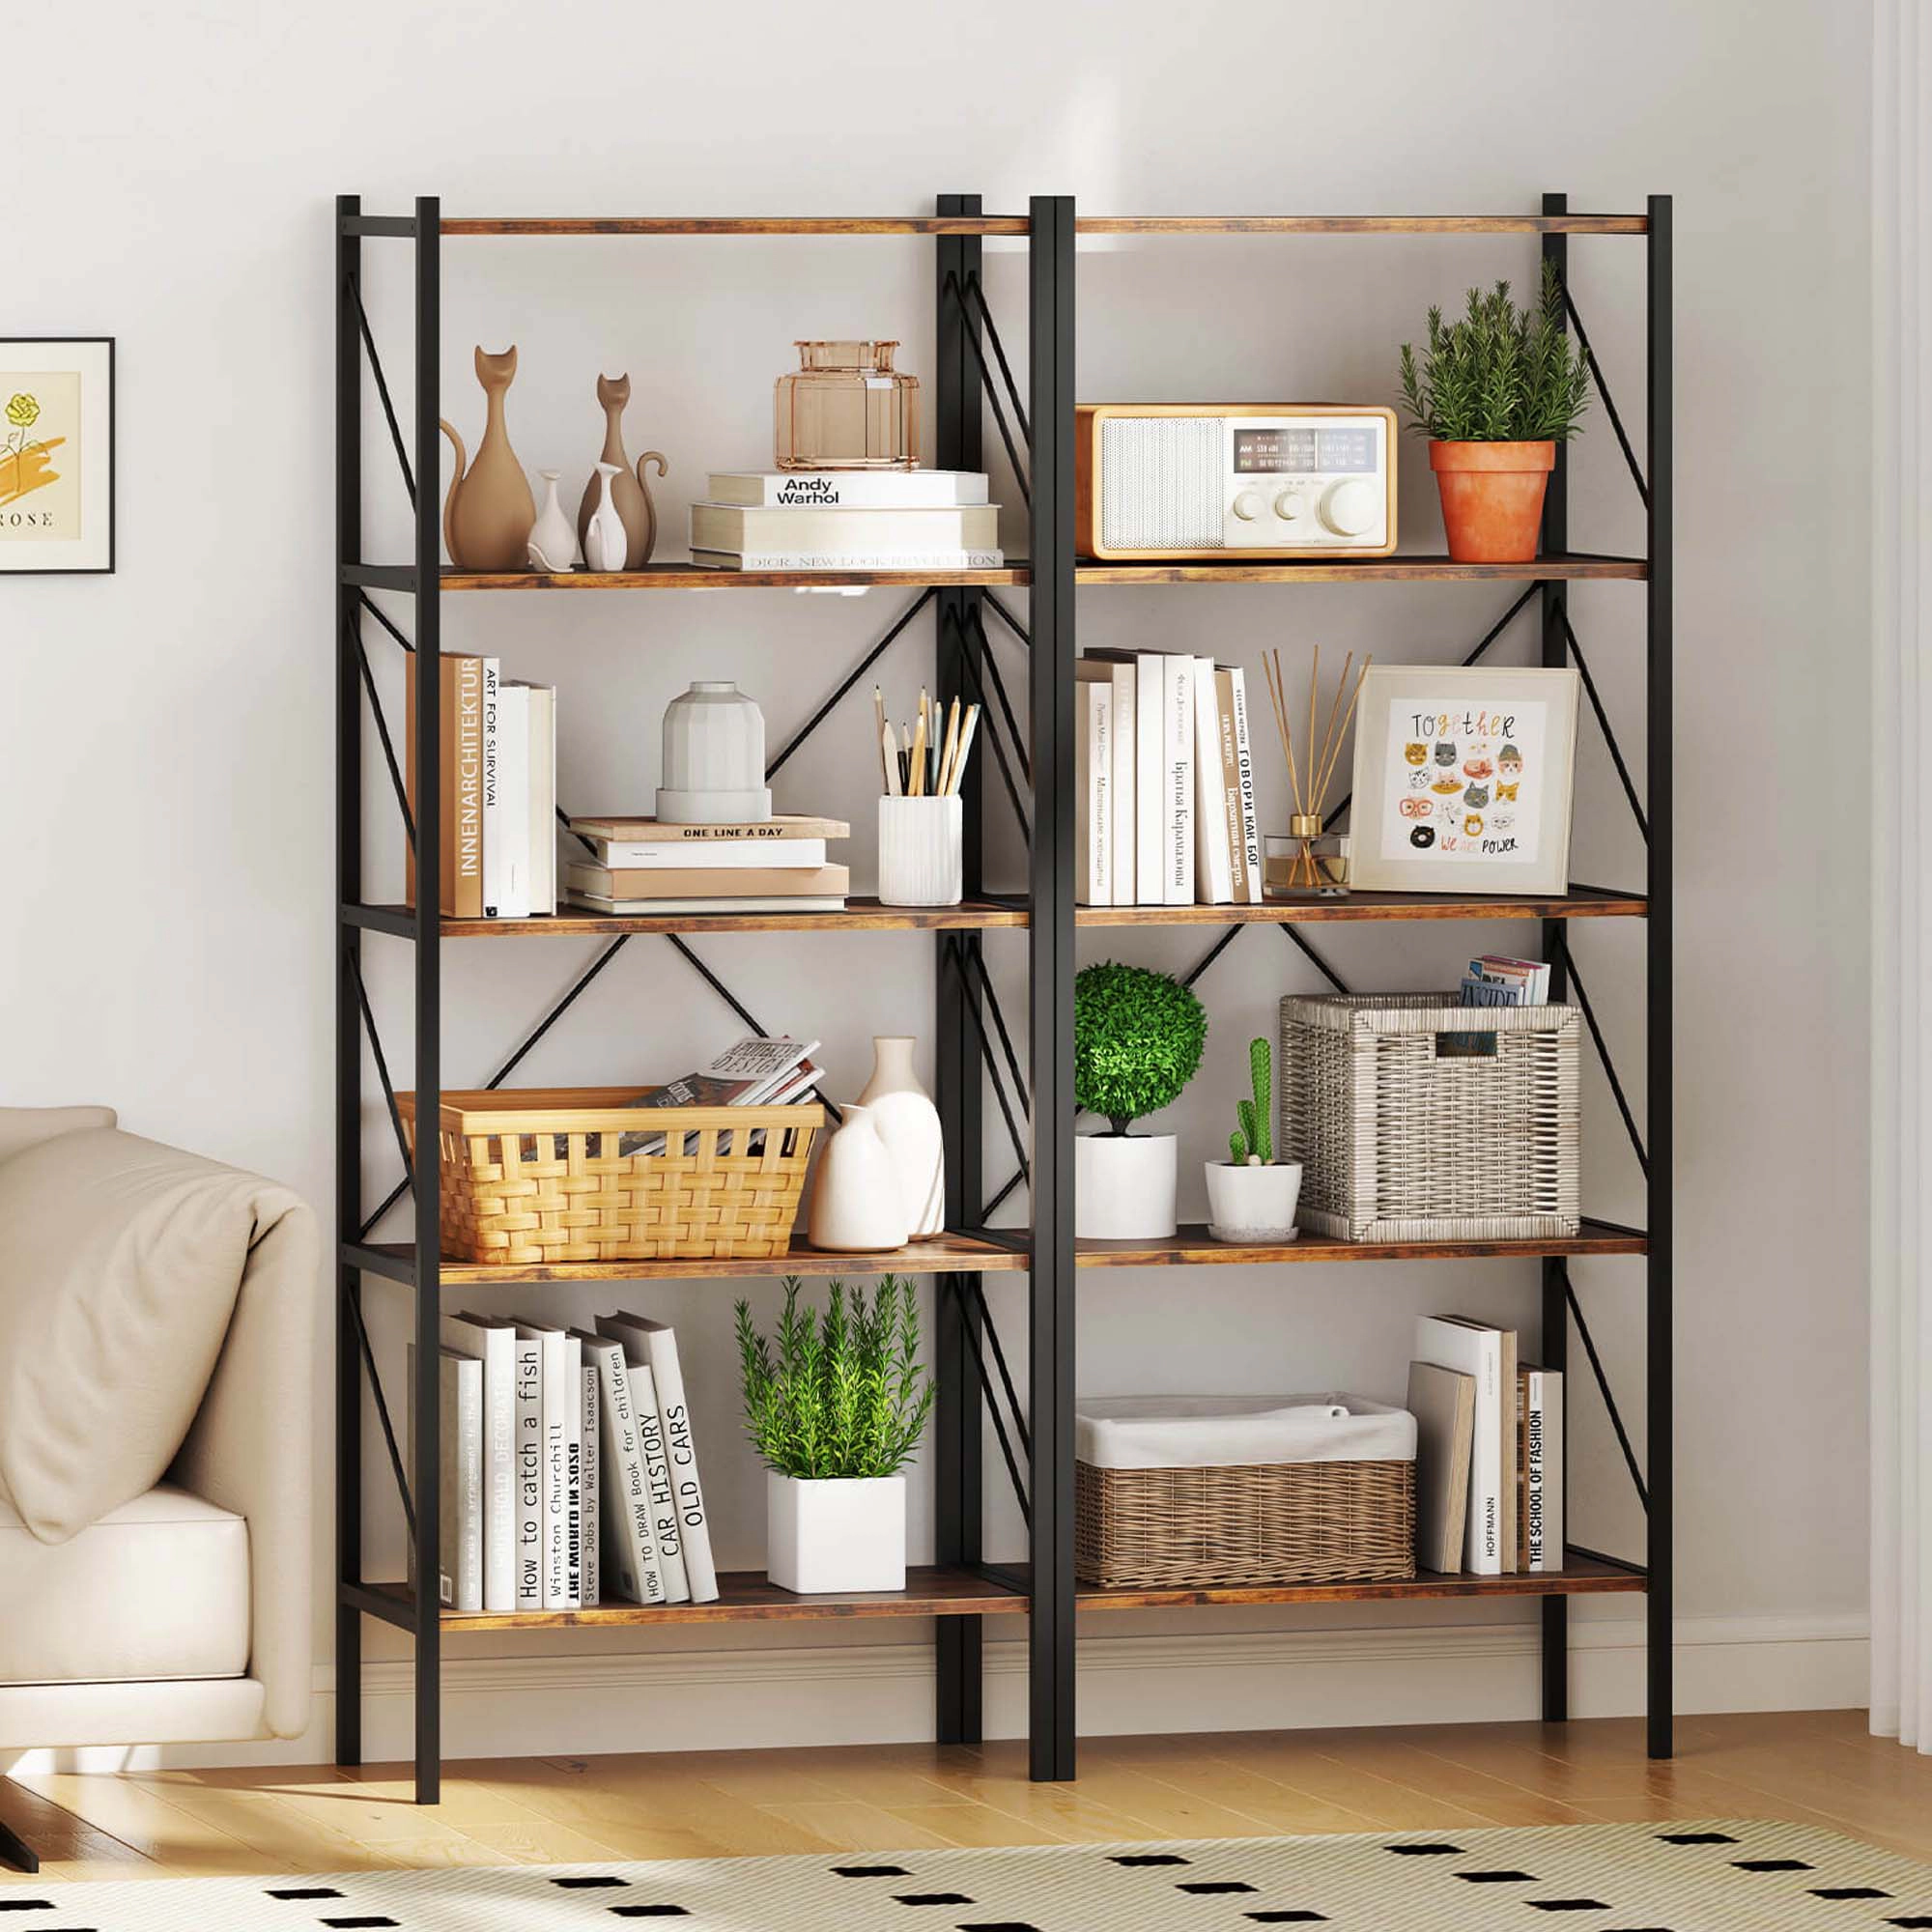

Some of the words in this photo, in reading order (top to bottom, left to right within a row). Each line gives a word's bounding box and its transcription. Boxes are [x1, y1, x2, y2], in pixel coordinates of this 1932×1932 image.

[777, 492, 839, 504] Warhol
[784, 478, 832, 494] Andy
[486, 668, 497, 696] ART
[486, 703, 497, 734] FOR
[462, 658, 478, 877] INNENARCHITEKTUR
[1171, 761, 1188, 806] Братья
[1239, 750, 1254, 810] ГОВОРИ
[684, 829, 708, 838] ONE
[715, 829, 742, 838] LINE
[758, 828, 782, 837] DAY
[1244, 816, 1256, 839] КАК
[1170, 809, 1188, 887] Карамазовы
[1247, 845, 1259, 867] БОГ
[519, 1352, 537, 1402] fish
[611, 1352, 629, 1420] children
[584, 1369, 595, 1432] Isaacson
[524, 1417, 537, 1429] a
[623, 1430, 634, 1452] for
[667, 1405, 692, 1465] CARS
[1530, 1410, 1543, 1463] FASHION
[519, 1443, 537, 1507] catch
[550, 1422, 561, 1514] Churchill
[584, 1442, 595, 1490] Walter
[627, 1461, 641, 1495] Book
[639, 1413, 671, 1504] HISTORY
[1530, 1467, 1543, 1484] OF
[584, 1497, 596, 1513] by
[634, 1503, 649, 1538] DRAW
[680, 1481, 703, 1526] OLD
[1530, 1487, 1543, 1536] SCHOOL
[520, 1521, 537, 1546] to
[584, 1521, 595, 1552] Jobs
[657, 1517, 679, 1556] CAR
[1487, 1497, 1495, 1556] HOFFMANN
[550, 1524, 561, 1597] Winston
[641, 1546, 653, 1562] TO
[1530, 1541, 1543, 1564] THE
[520, 1559, 537, 1598] How
[585, 1561, 595, 1601] Steve
[645, 1571, 659, 1598] HOW
